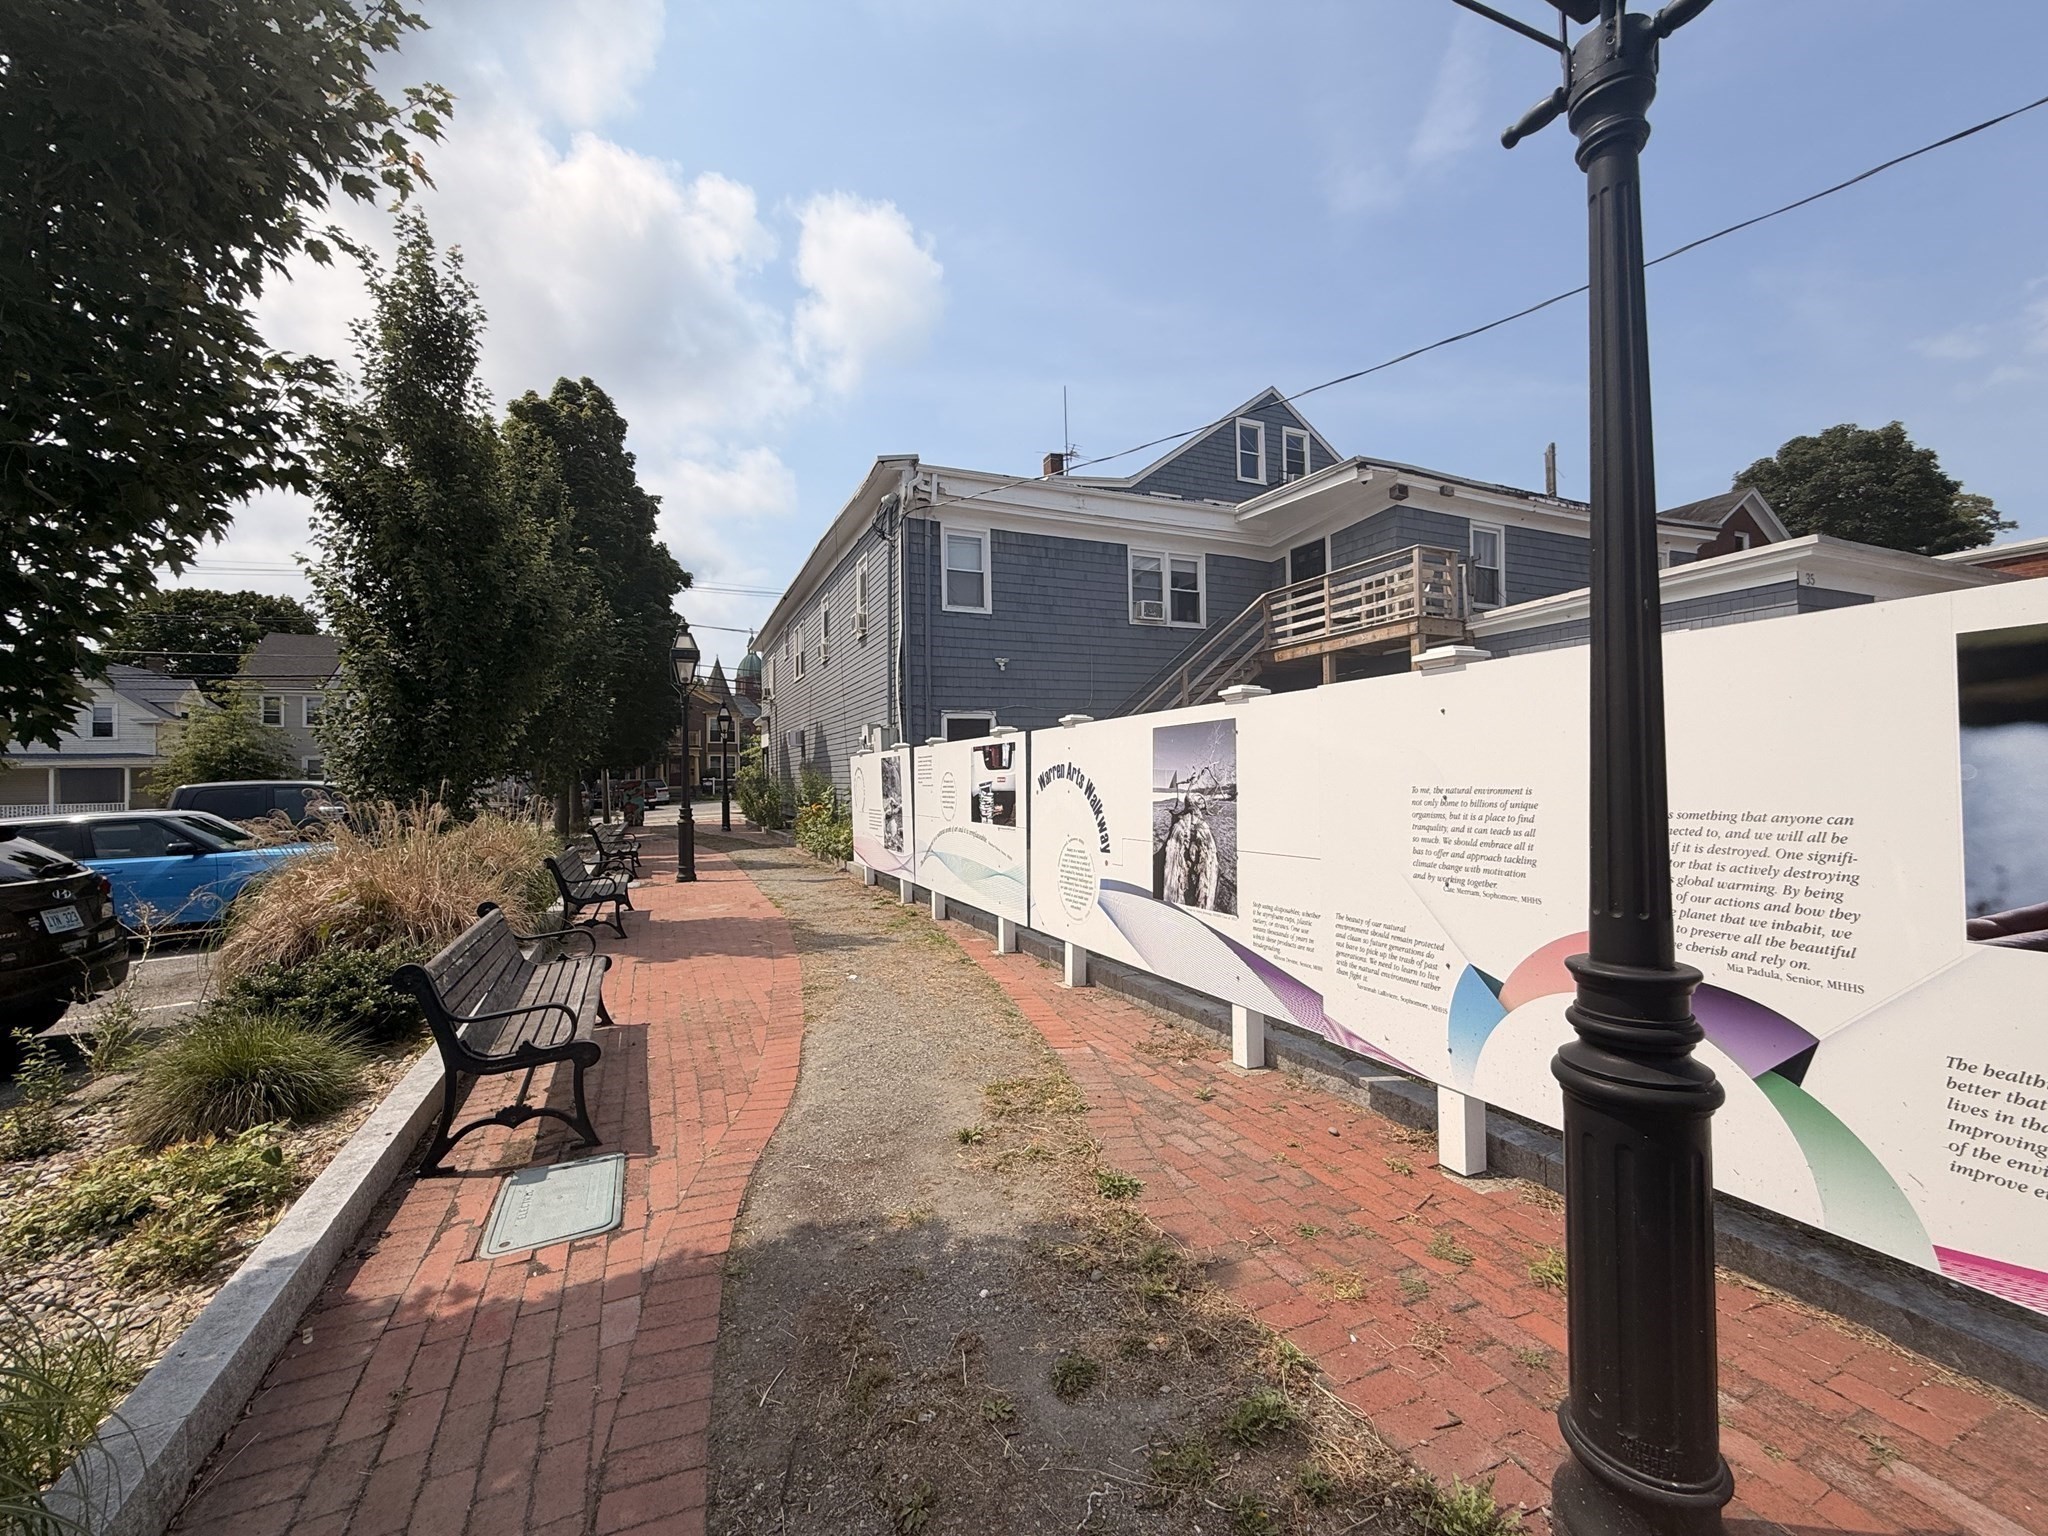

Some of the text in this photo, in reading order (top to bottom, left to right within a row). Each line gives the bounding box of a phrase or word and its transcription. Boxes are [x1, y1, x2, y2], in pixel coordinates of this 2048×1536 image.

[1806, 573, 1815, 585] 35
[1412, 786, 1532, 795] To me, the natural environment is
[1038, 764, 1064, 791] Warren
[1066, 762, 1085, 789] Arts
[1084, 778, 1111, 853] Walkway
[1424, 799, 1438, 808] only
[1470, 800, 1497, 808] billions
[1500, 800, 1508, 811] of
[1510, 802, 1538, 811] unique
[1677, 810, 1737, 824] something
[1741, 811, 1767, 823] that
[1771, 814, 1822, 826] anyone
[1827, 815, 1854, 826] can
[1412, 812, 1447, 820] organisms,
[1449, 812, 1461, 820] but
[1463, 812, 1468, 820] it
[1485, 813, 1505, 823] place
[1508, 815, 1515, 823] to
[1516, 814, 1535, 825] find
[1451, 825, 1465, 833] and
[1467, 826, 1472, 834] it
[1490, 827, 1511, 836] teach
[1524, 828, 1536, 838] all
[1421, 836, 1440, 844] much.
[1454, 837, 1478, 847] should
[1480, 840, 1512, 850] embrace
[1514, 842, 1525, 850] all
[1528, 843, 1534, 851] it
[1706, 829, 1721, 840] to,
[1725, 829, 1750, 840] and
[1755, 832, 1772, 841] we
[1777, 830, 1803, 842] will
[1807, 831, 1826, 844] all
[1831, 833, 1848, 845] be
[1413, 847, 1423, 855] has
[1433, 848, 1449, 859] offer
[1451, 851, 1465, 859] and
[1466, 853, 1502, 862] approach
[1504, 855, 1537, 868] tackling
[1671, 842, 1858, 866] if it is destroyed. One signifi-
[1413, 859, 1526, 878] climate change with motivation
[1413, 872, 1498, 888] and by working together.
[1689, 859, 1712, 871] that
[1717, 862, 1726, 872] is
[1729, 863, 1779, 879] actively
[1783, 867, 1860, 886] destroying
[1482, 890, 1519, 902] Sophomore,
[1521, 896, 1542, 905] MHHS
[1677, 875, 1714, 888] global
[1717, 881, 1778, 896] warming.
[1783, 884, 1800, 898] By
[1804, 886, 1844, 904] being
[1676, 892, 1860, 924] of our actions and how they
[1346, 914, 1363, 926] beauty
[1365, 919, 1371, 927] of
[1383, 923, 1406, 932] natural
[1678, 908, 1716, 922] planet
[1720, 913, 1745, 926] that
[1750, 919, 1767, 928] we
[1771, 919, 1825, 938] inhabit,
[1832, 928, 1852, 939] we
[1335, 923, 1445, 951] environment should remain protected
[1347, 933, 1361, 942] clean
[1369, 939, 1387, 948] future
[1388, 944, 1424, 957] generations
[1426, 951, 1434, 959] do
[1676, 925, 1856, 959] to preserve all the beautiful
[1346, 941, 1358, 951] have
[1366, 947, 1378, 956] pick
[1388, 952, 1397, 960] the
[1399, 954, 1415, 964] trash
[1416, 959, 1424, 968] of
[1424, 962, 1438, 970] past
[1686, 941, 1727, 957] cherish
[1731, 950, 1756, 962] and
[1760, 955, 1785, 968] rely
[1790, 959, 1810, 970] on.
[1727, 963, 1865, 994] Mia Padula, Senior, MHHS
[1946, 1055, 2048, 1090] The health
[1946, 1076, 2048, 1111] better that
[1947, 1097, 1989, 1118] lives
[1995, 1110, 2015, 1125] in
[1947, 1119, 2048, 1159] Improving
[1948, 1141, 1969, 1157] of
[1972, 1147, 2002, 1164] the
[1950, 1160, 2028, 1193] improve
